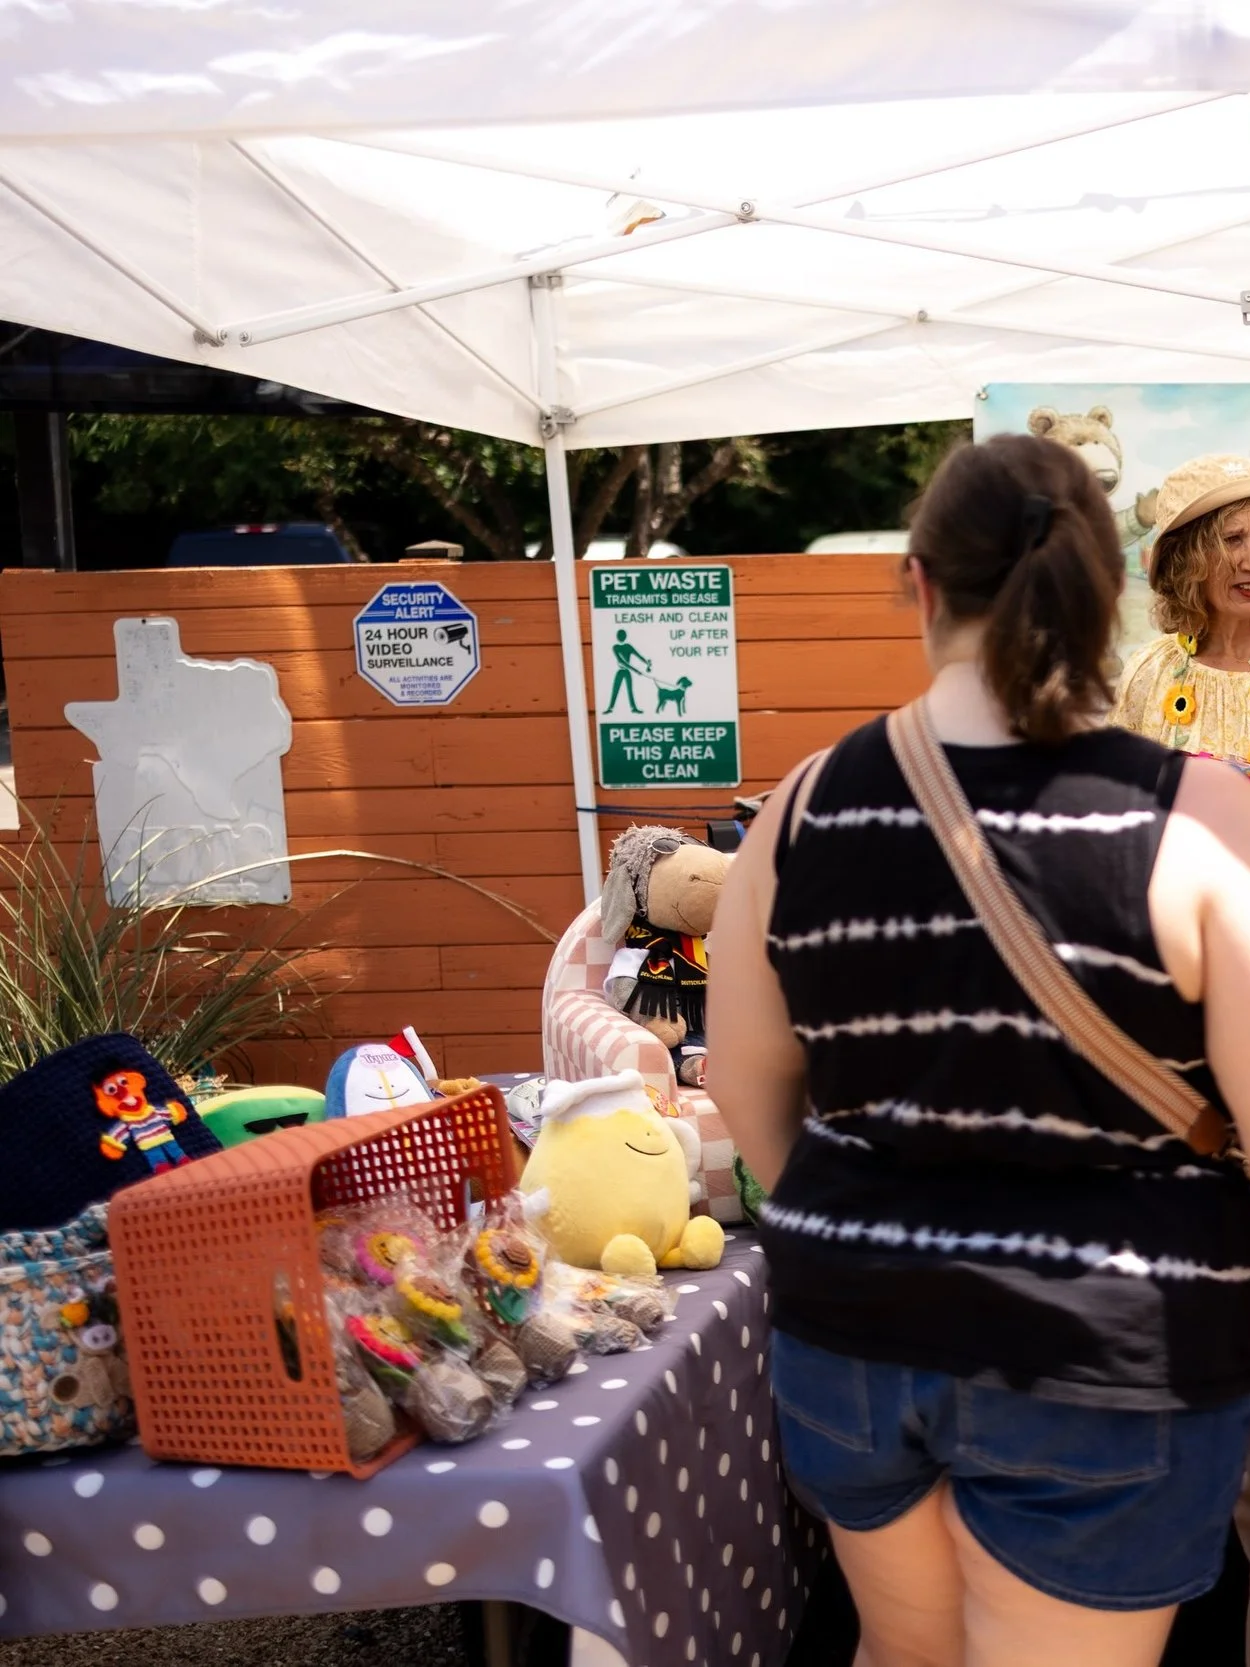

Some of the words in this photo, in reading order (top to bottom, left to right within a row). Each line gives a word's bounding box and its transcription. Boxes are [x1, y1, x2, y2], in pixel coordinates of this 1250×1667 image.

[601, 573, 640, 591] PET
[650, 572, 722, 590] WASTE
[382, 592, 444, 606] SECURITY
[606, 594, 667, 605] TRANSMITS
[672, 593, 719, 604] DISEASE
[394, 606, 434, 619] ALERT
[614, 613, 654, 624] LEASH
[659, 613, 684, 623] AND
[688, 612, 728, 622] CLEAN
[365, 629, 382, 641] 24
[387, 627, 428, 640] HOUR
[670, 630, 687, 640] UP
[690, 629, 728, 640] AFTER
[366, 643, 412, 656] VIDEO
[669, 647, 702, 657] YOUR
[707, 646, 729, 656] PET
[367, 657, 454, 669] SURVEILLANCE
[609, 728, 674, 742] PLEASE
[681, 728, 727, 741] KEEP
[623, 746, 662, 760] THIS
[669, 745, 715, 760] AREA
[641, 764, 699, 778] CLEAN
